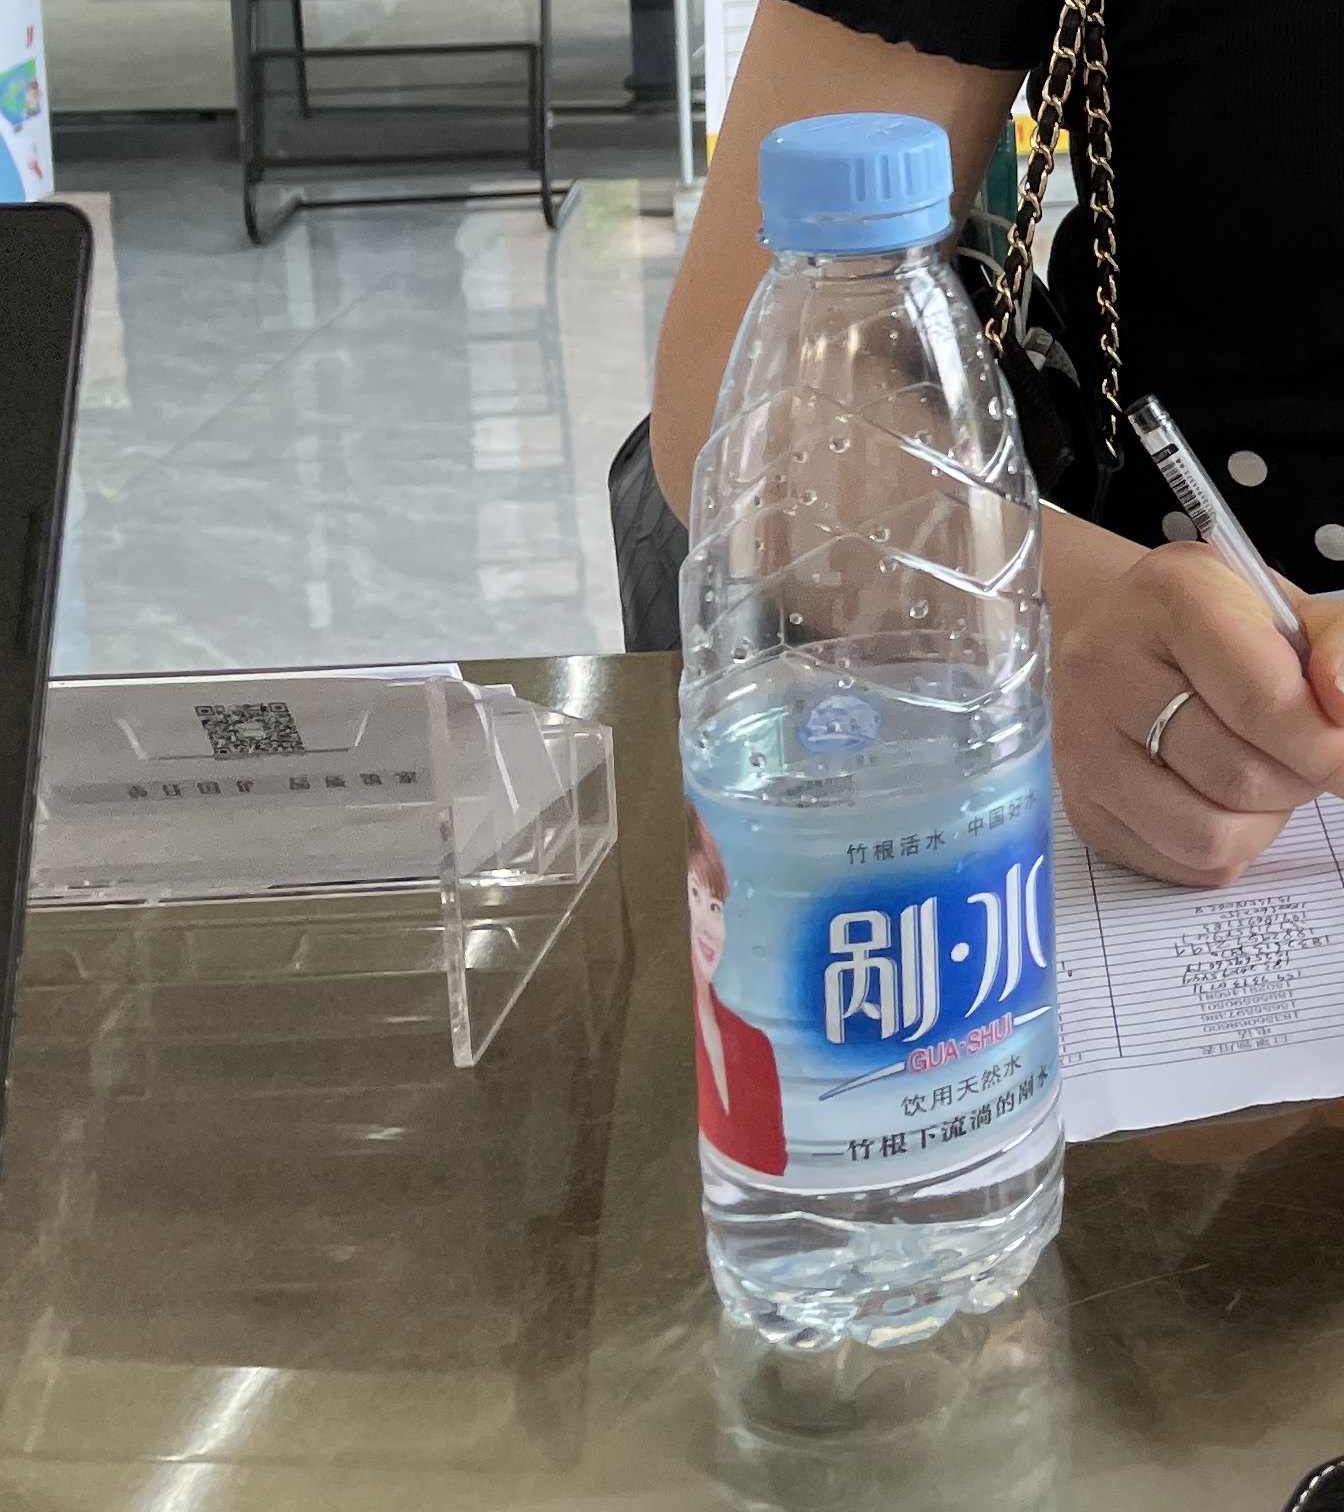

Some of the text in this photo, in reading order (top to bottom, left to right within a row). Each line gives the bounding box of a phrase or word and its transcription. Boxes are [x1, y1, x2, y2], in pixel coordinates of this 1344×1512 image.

[846, 829, 946, 865] 竹根活水
[901, 1054, 1022, 1118] 饮用天然水
